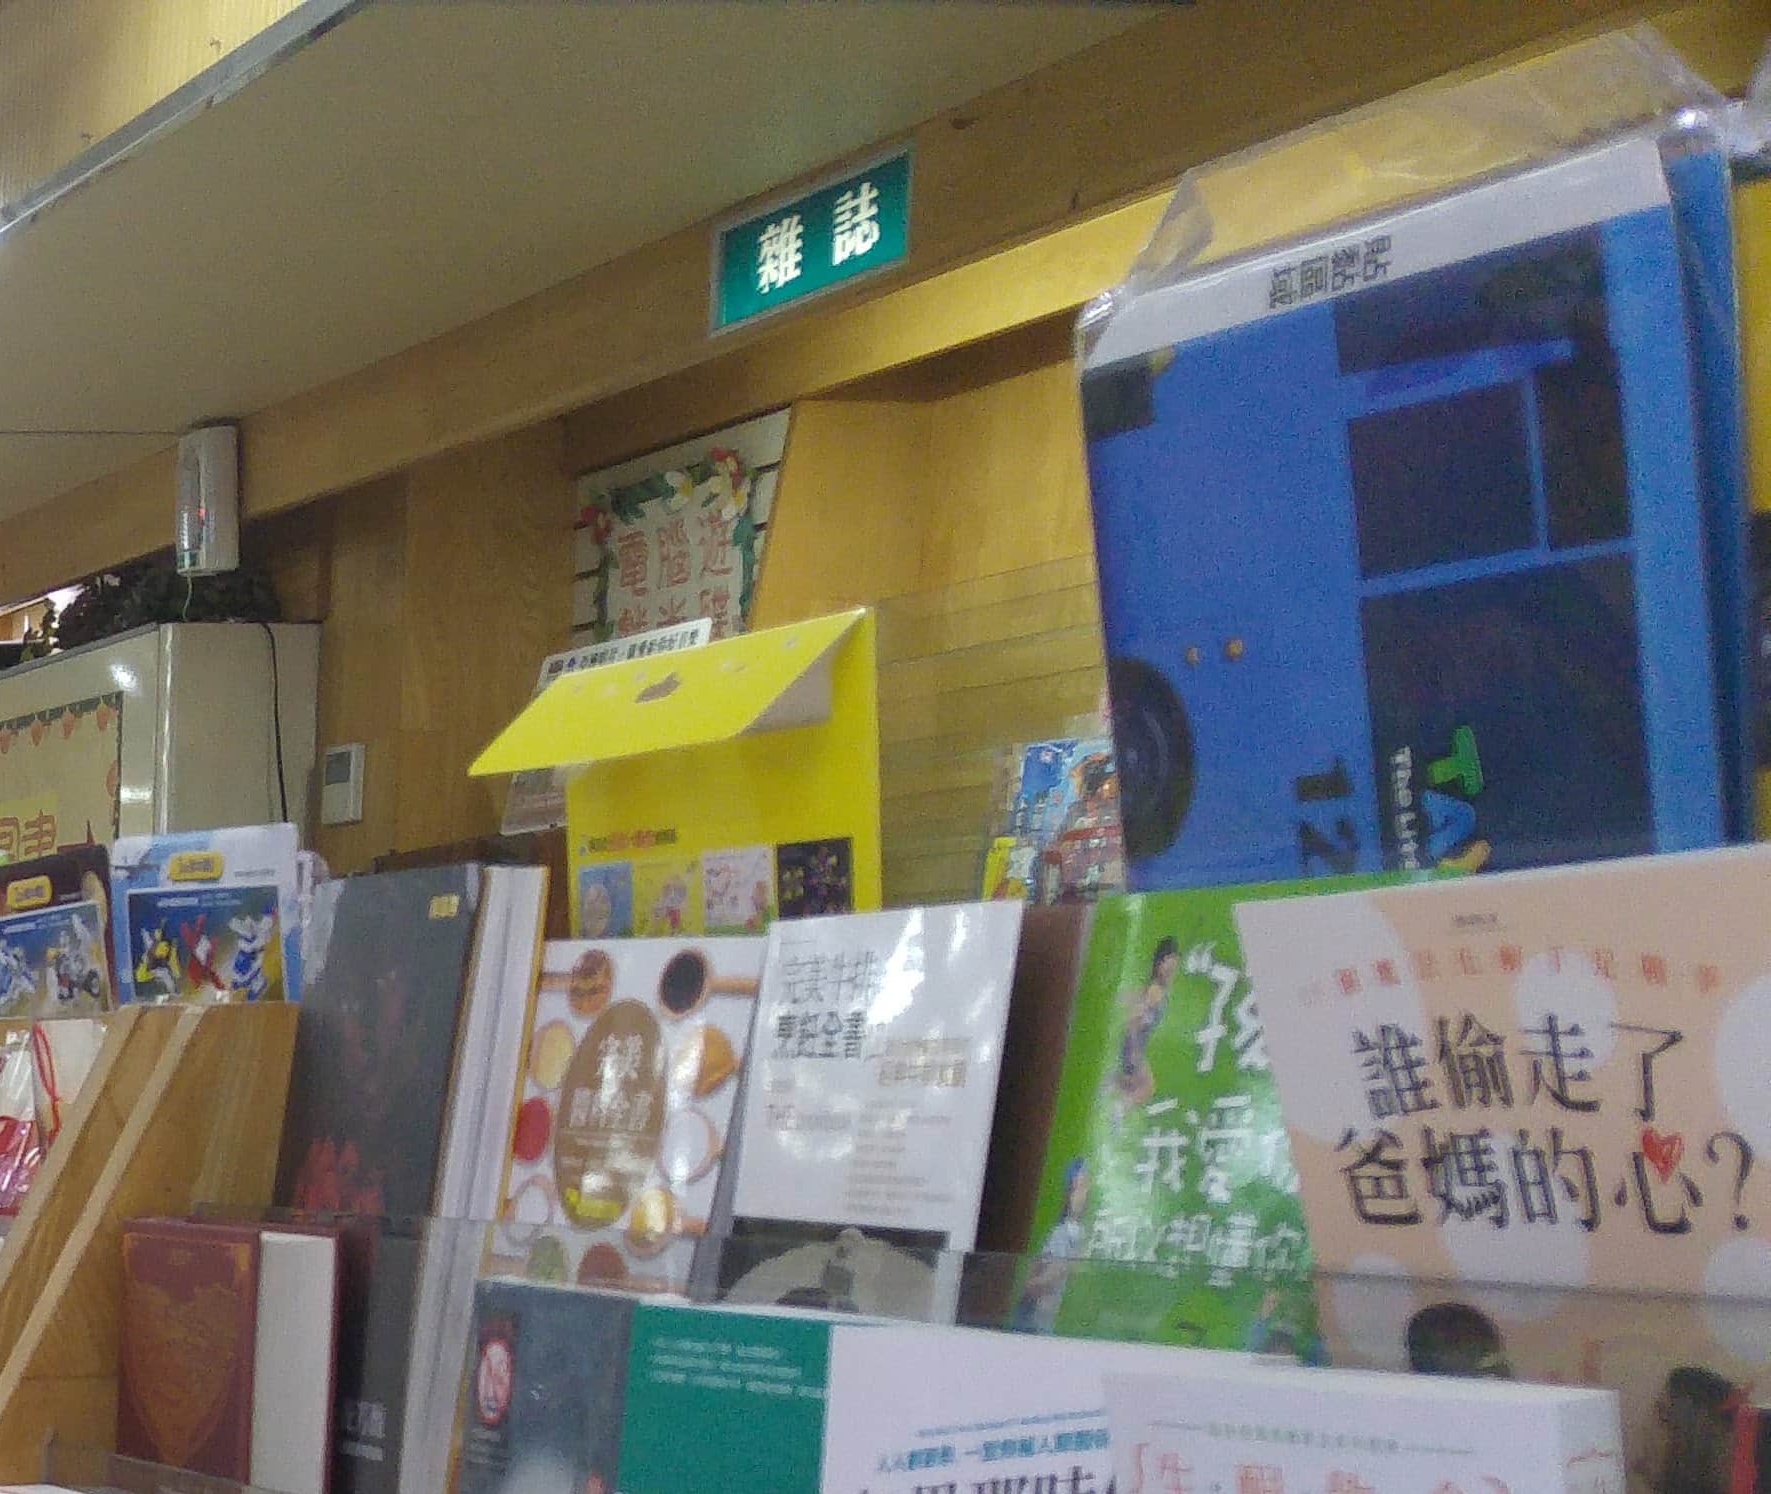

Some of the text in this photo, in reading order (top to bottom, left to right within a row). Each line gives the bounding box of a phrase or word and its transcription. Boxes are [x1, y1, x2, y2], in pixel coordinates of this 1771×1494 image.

[756, 181, 880, 296] 雜誌
[1352, 1011, 1684, 1123] 誰偷走了
[1337, 1124, 1755, 1239] 爸媽的心?
